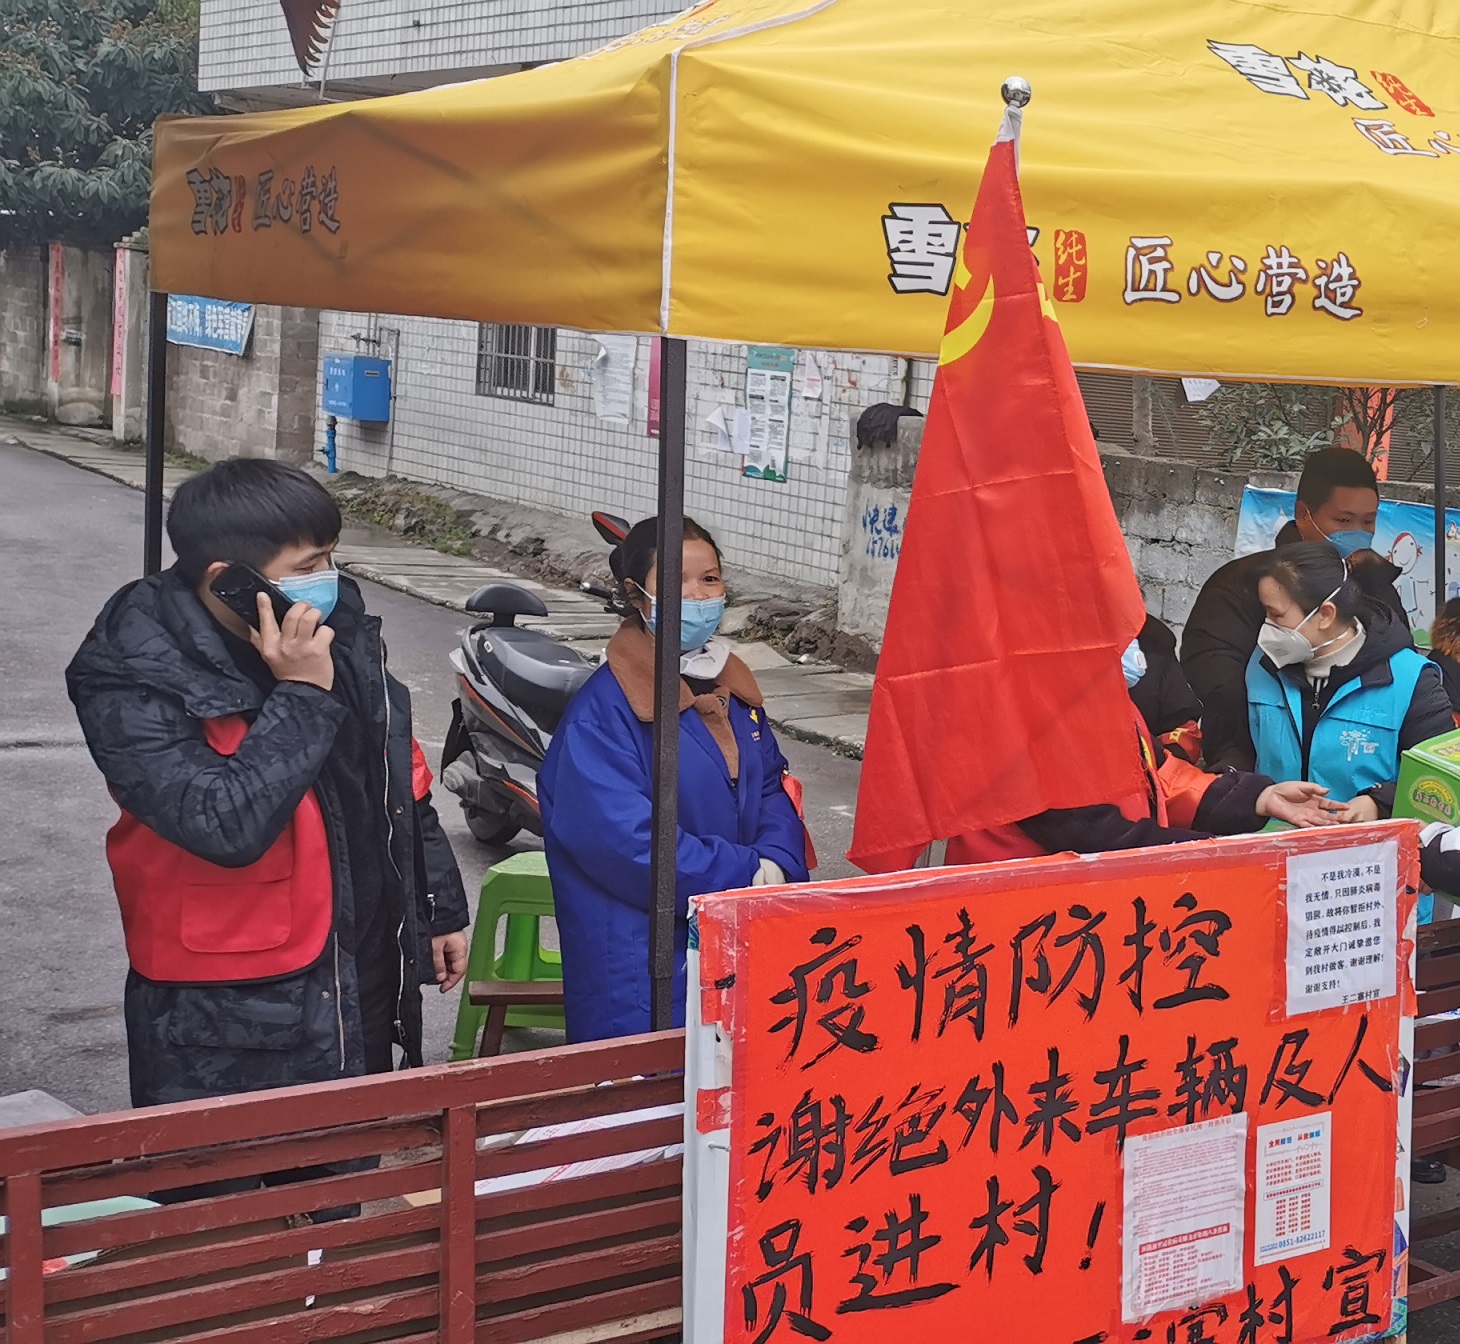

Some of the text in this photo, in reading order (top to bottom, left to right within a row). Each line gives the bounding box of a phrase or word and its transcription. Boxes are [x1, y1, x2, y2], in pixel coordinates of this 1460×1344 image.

[1206, 39, 1388, 111] 雪花
[252, 165, 341, 235] 匠心营造
[1053, 229, 1088, 303] 纯生
[1122, 236, 1364, 321] 匠心营造
[768, 893, 1232, 1076] 疫情防控
[747, 1014, 1393, 1200] 谢绝外来车辆及人
